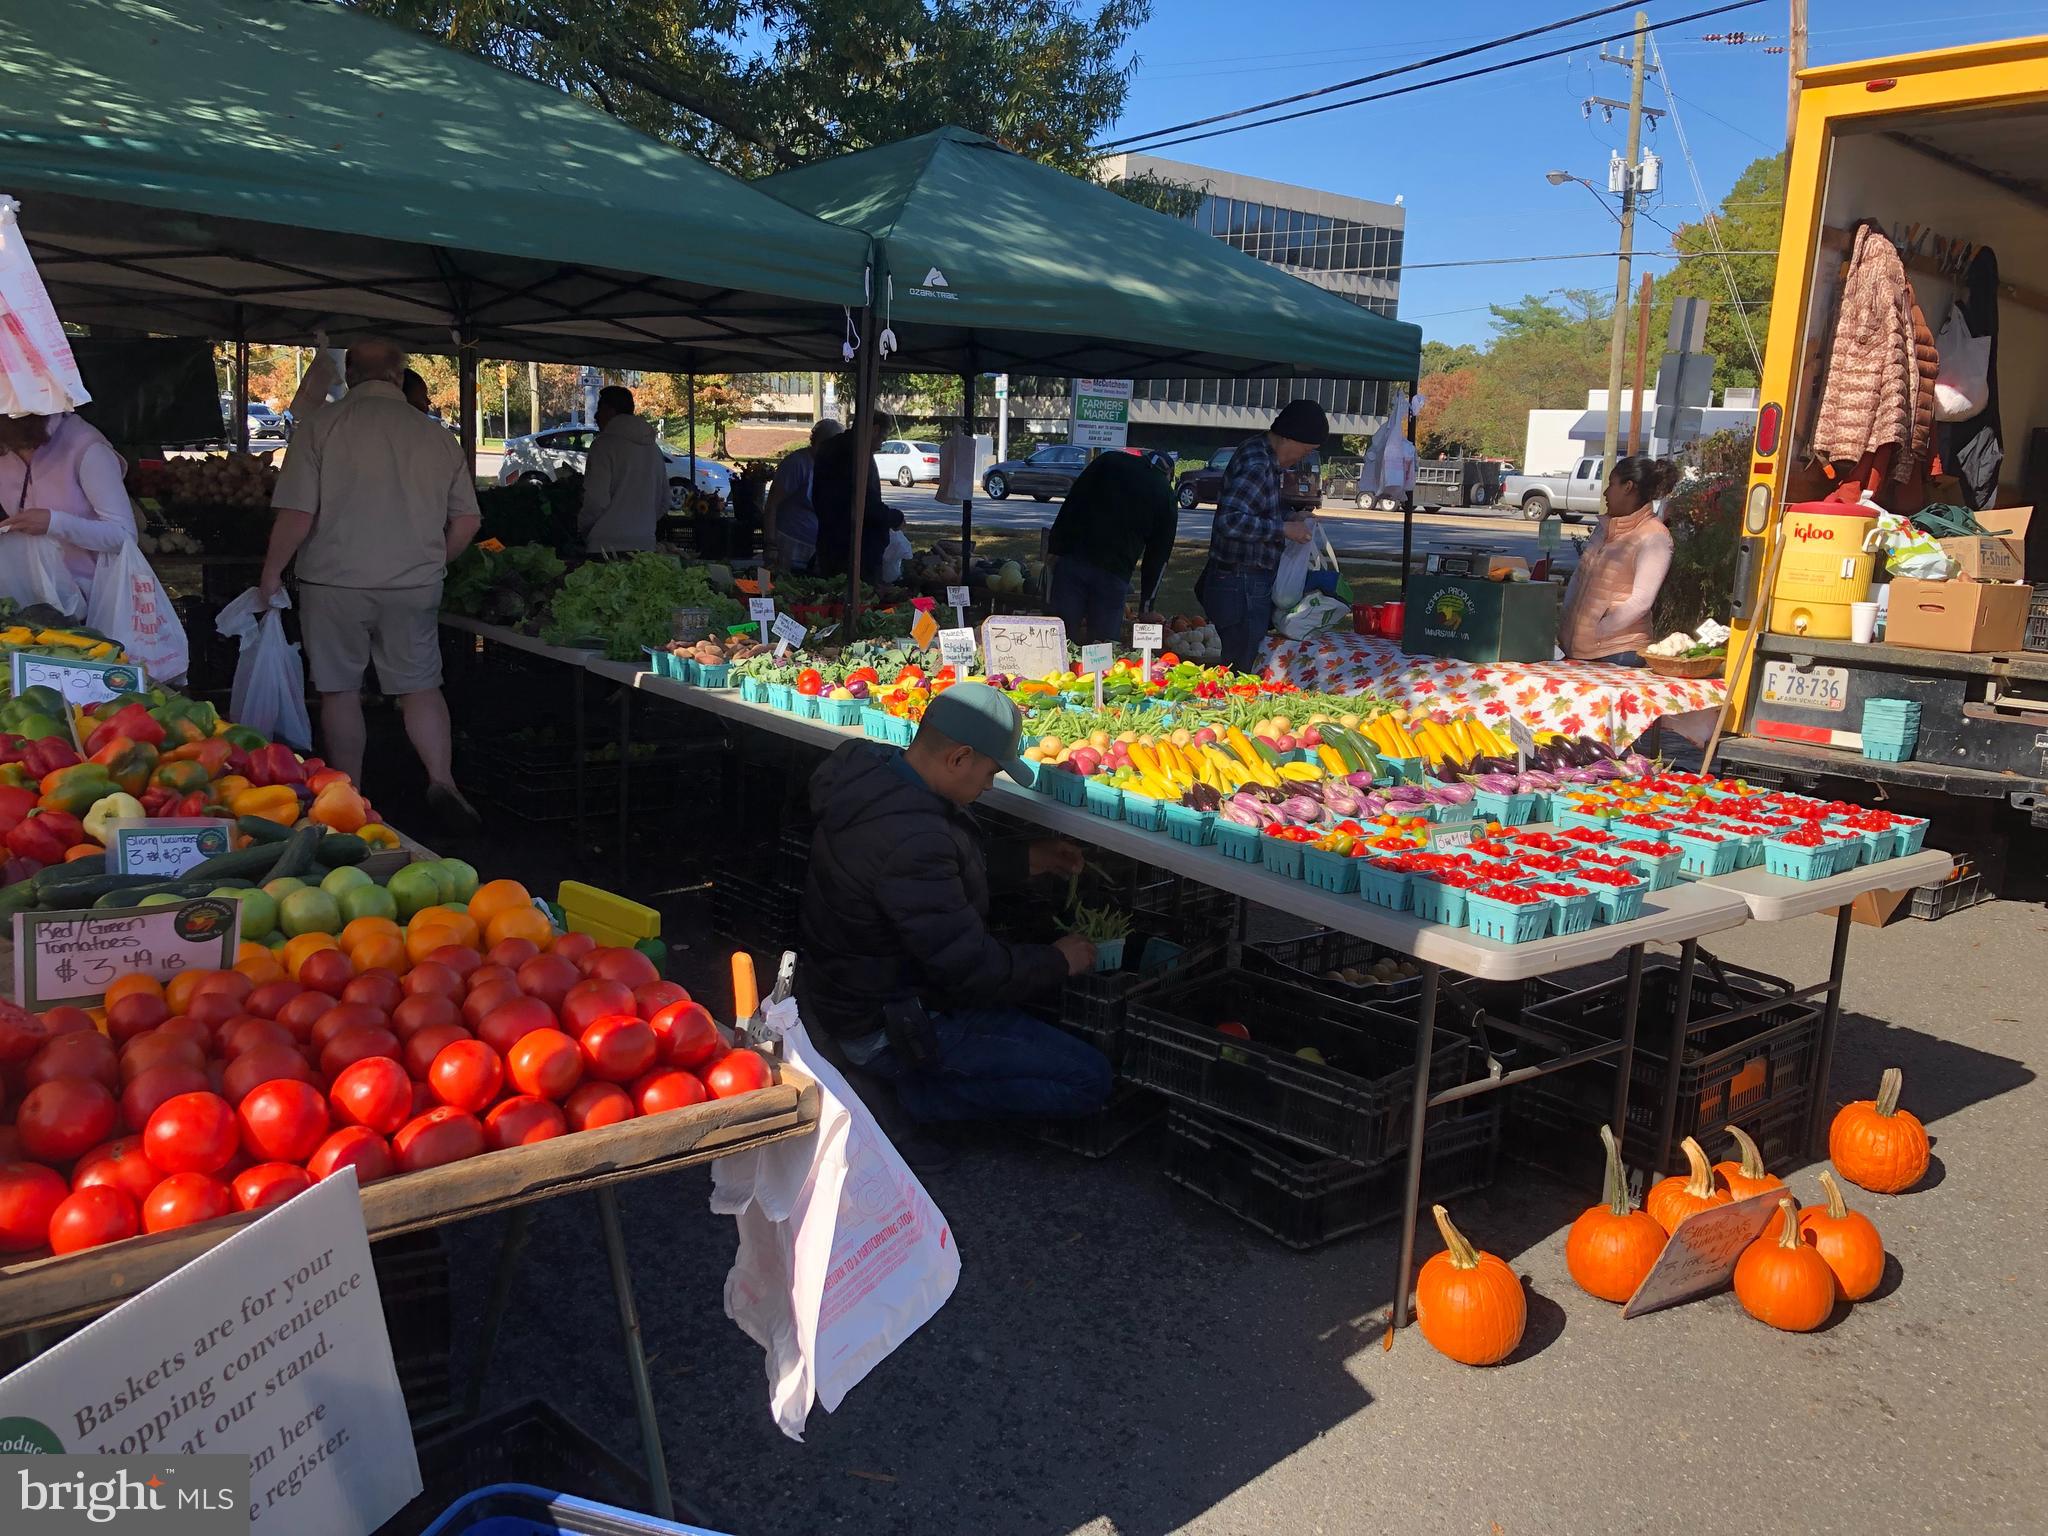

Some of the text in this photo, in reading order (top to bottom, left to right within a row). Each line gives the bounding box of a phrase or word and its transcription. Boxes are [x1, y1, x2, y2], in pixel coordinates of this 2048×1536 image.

[1082, 399, 1124, 411] FARMERS
[1083, 409, 1121, 421] MARKET
[1794, 523, 1834, 543] igloo
[1981, 550, 2011, 567] T-Shirt
[1425, 589, 1446, 615] OCHOA
[992, 627, 1012, 652] 3
[1460, 632, 1470, 641] VA
[29, 664, 46, 682] 3
[1768, 673, 1840, 699] F 78-736
[129, 849, 144, 865] 3
[36, 936, 141, 954] Tomatoes
[844, 1258, 855, 1273] TO
[857, 1222, 899, 1261] PARTICIPATING
[897, 1210, 915, 1231] STOR
[223, 1272, 362, 1382] convenience
[73, 1248, 334, 1440] Baskets are for your
[214, 1391, 257, 1435] our
[265, 1331, 334, 1397] stand.
[279, 1402, 327, 1451] here
[264, 1426, 351, 1498] register.
